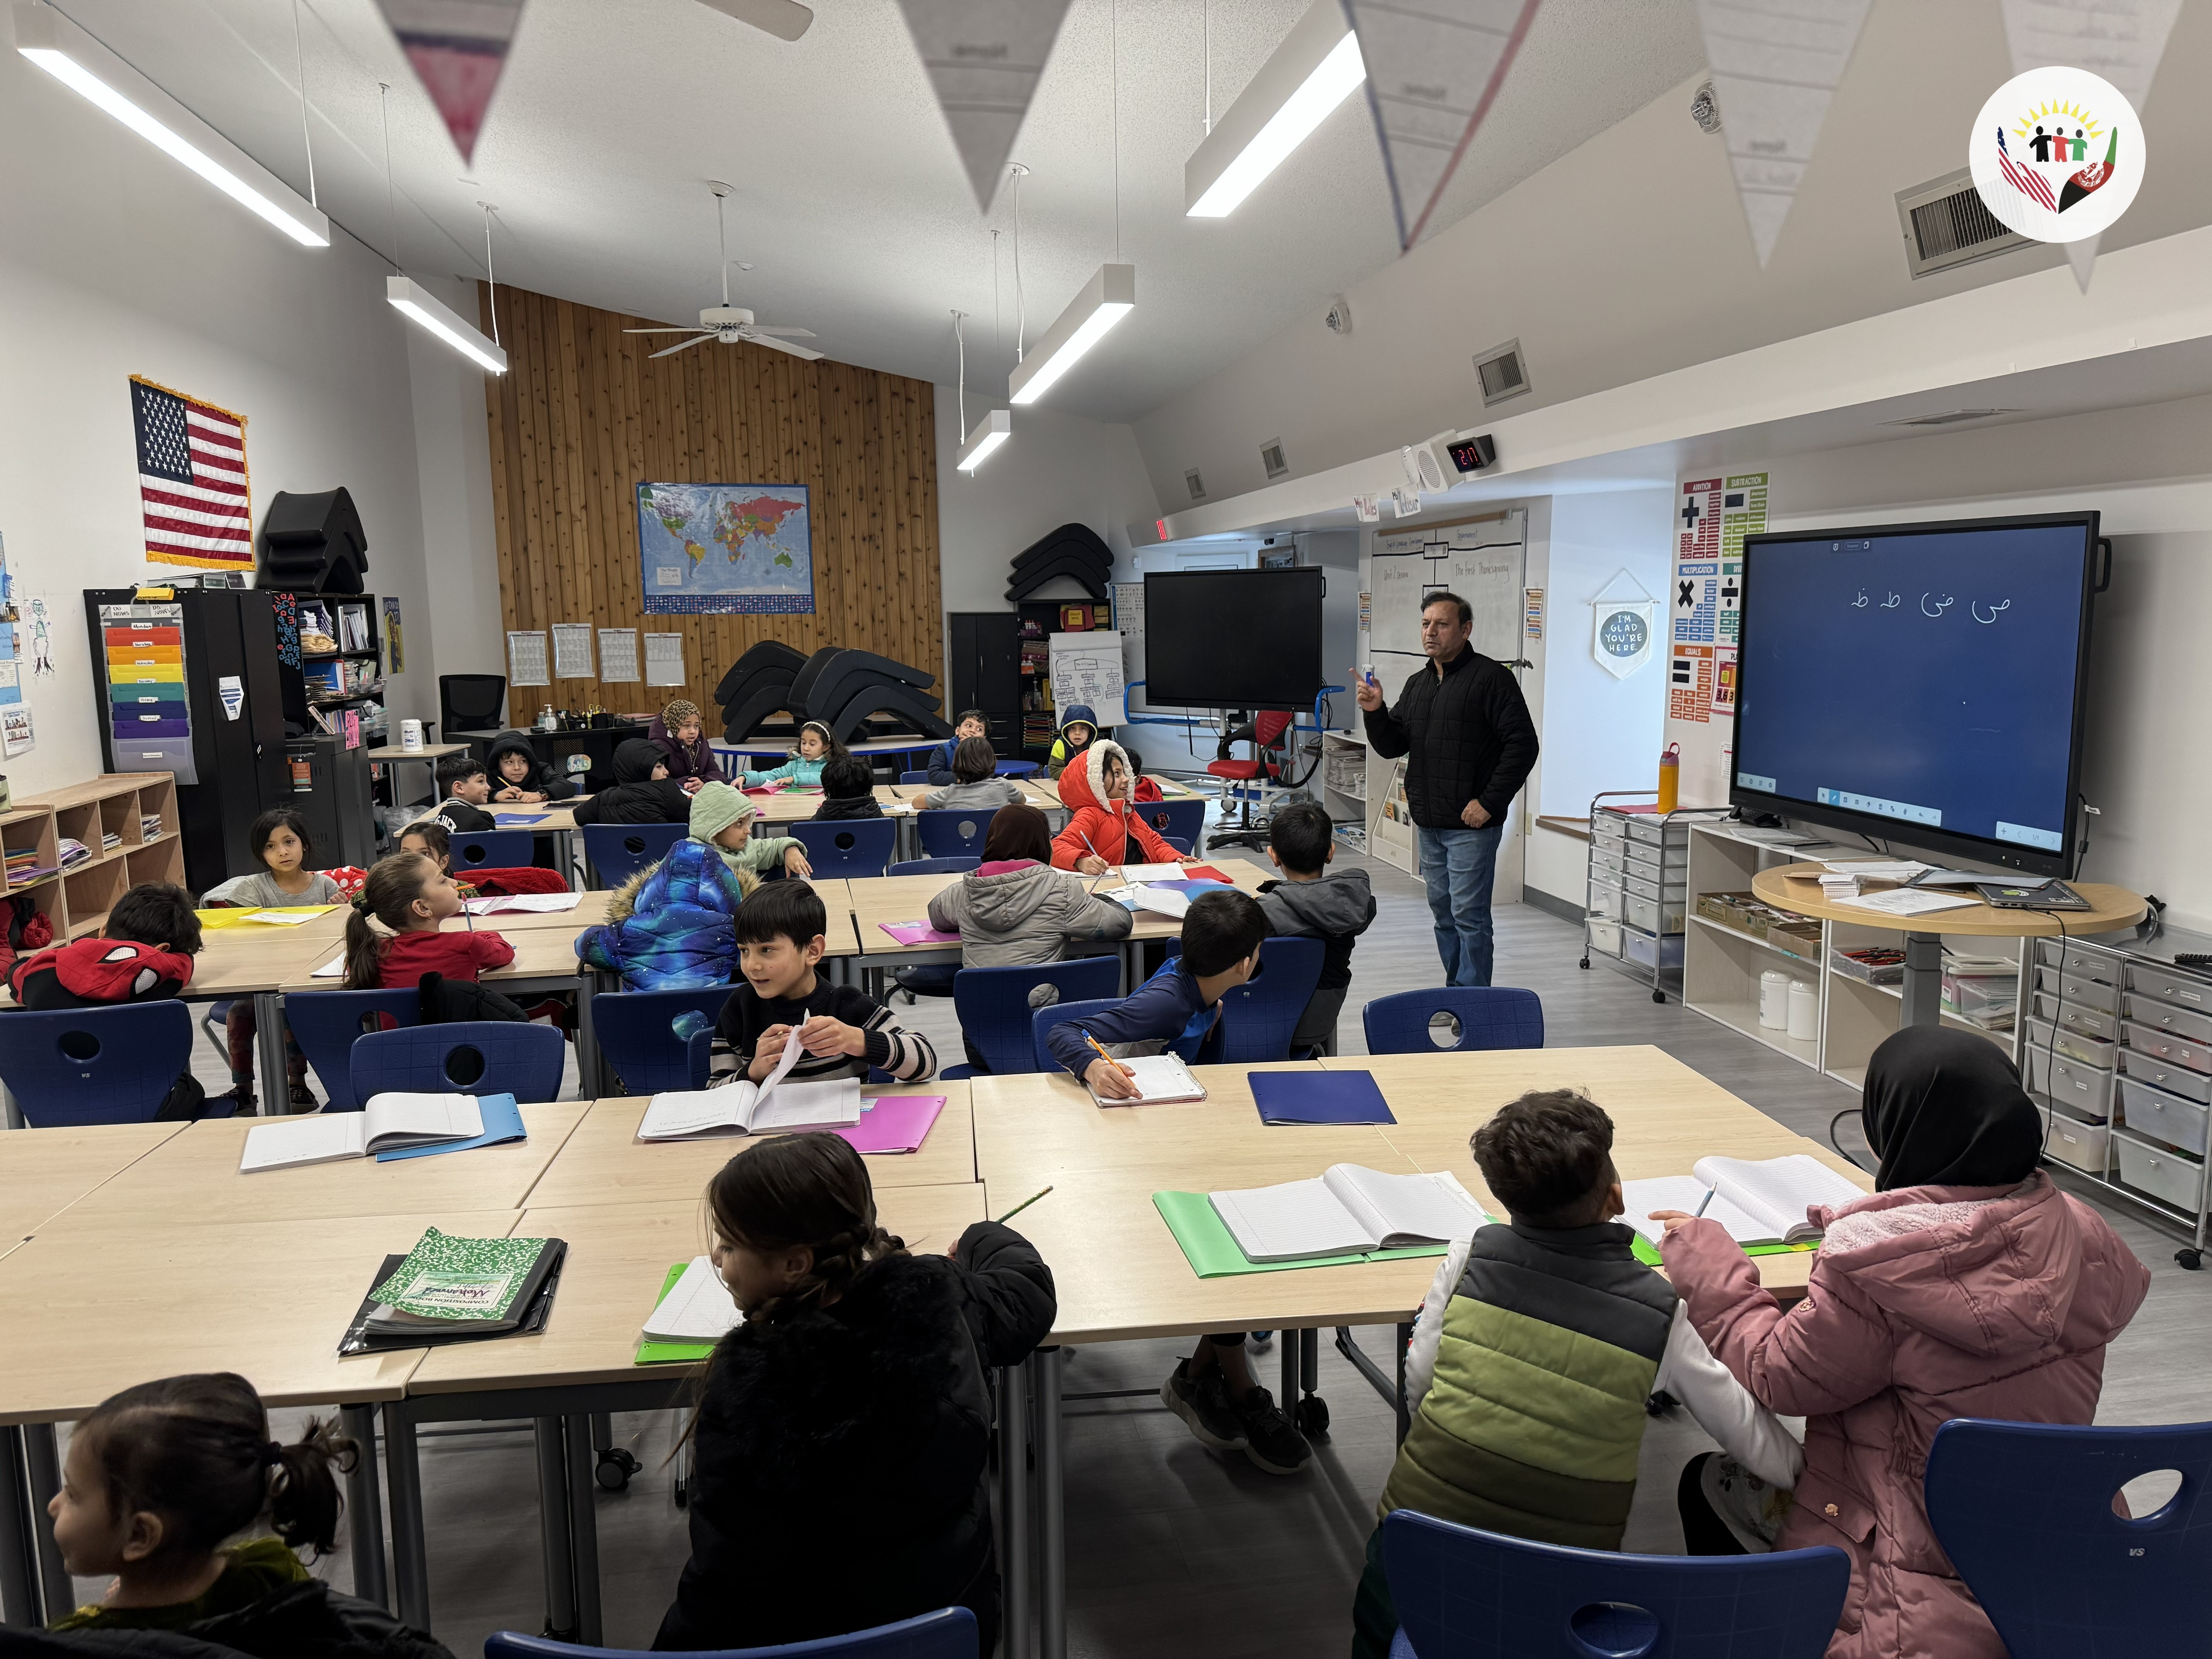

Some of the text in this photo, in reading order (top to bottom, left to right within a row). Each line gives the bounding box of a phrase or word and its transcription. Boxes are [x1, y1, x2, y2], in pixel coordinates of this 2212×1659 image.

[1731, 476, 1761, 487] SUBTRACTION
[1693, 483, 1711, 491] ADDITION
[1384, 565, 1409, 580] Unit 2 review
[1478, 562, 1510, 584] Thanksgiving
[1682, 566, 1714, 574] MULTIPLICATION
[1618, 615, 1631, 623] I'M
[1611, 624, 1637, 632] GLAD
[1605, 633, 1642, 642] YOU'RE
